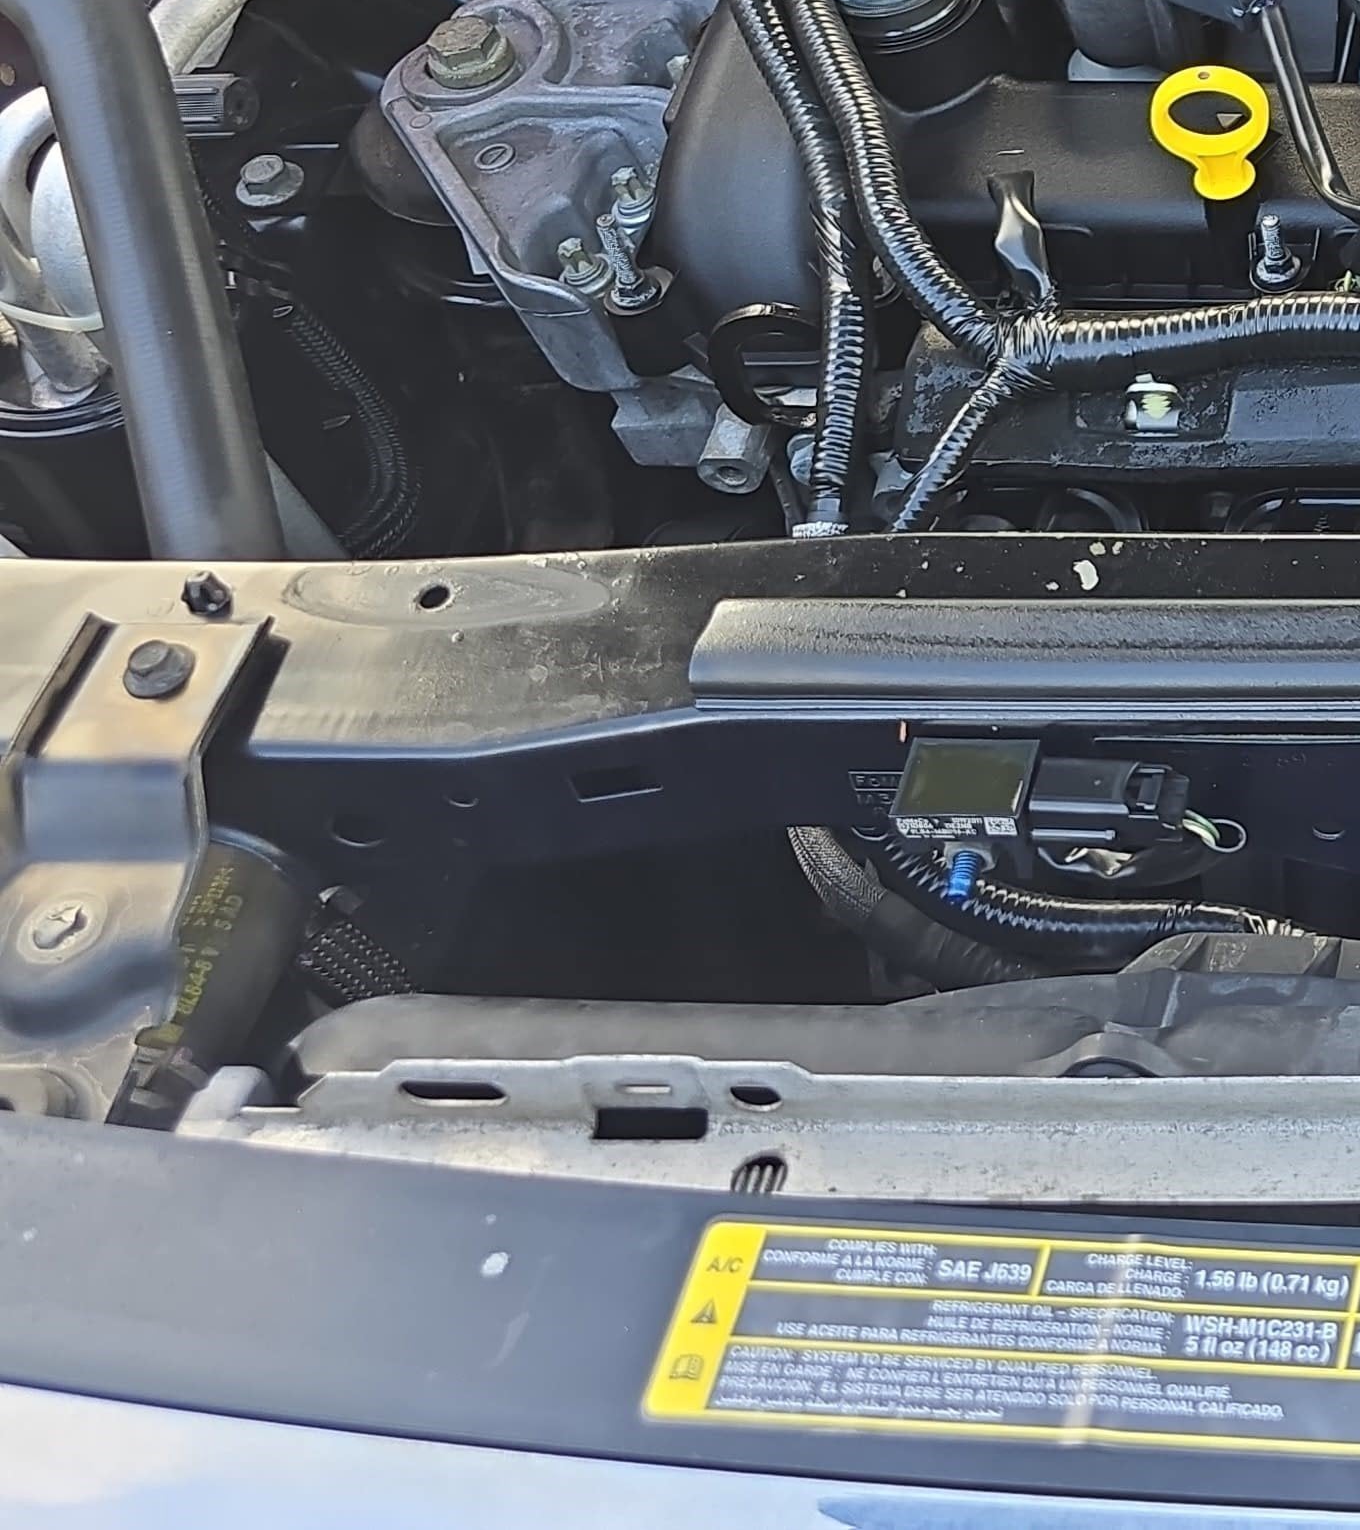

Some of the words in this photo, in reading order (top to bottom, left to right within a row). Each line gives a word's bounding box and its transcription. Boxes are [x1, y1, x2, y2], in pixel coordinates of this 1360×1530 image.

[828, 1239, 897, 1254] COMPLIES
[706, 1257, 744, 1273] A/C
[763, 1250, 840, 1266] CONFORME
[855, 1256, 874, 1268] LA
[875, 1256, 925, 1270] NORME
[1087, 1254, 1143, 1267] CHARGE
[1144, 1256, 1193, 1270] LEVEL:
[835, 1268, 892, 1282] CUMPLE
[936, 1260, 982, 1279] SAE
[983, 1263, 1032, 1286] J639
[1124, 1268, 1182, 1283] CHARGE
[1045, 1280, 1095, 1295] CARGA
[1096, 1282, 1118, 1296] DE
[1194, 1269, 1236, 1289] 1.56
[1239, 1272, 1259, 1289] lb
[1262, 1273, 1310, 1295] (0.71
[1313, 1276, 1351, 1301] kg)
[932, 1300, 1031, 1318] REFRIGERANT
[1032, 1305, 1054, 1318] OIL
[776, 1322, 806, 1335] USE
[806, 1324, 858, 1338] ACEITE
[860, 1327, 898, 1342] PARA
[900, 1330, 1016, 1346] REFRIGERANTES
[1018, 1335, 1097, 1350] CONFORME
[926, 1316, 969, 1330] HUILE
[971, 1318, 991, 1331] DE
[1113, 1324, 1163, 1339] NORME
[1184, 1314, 1338, 1339] WSH-M1C231-B
[1183, 1336, 1198, 1355] 5
[1201, 1337, 1217, 1355] fl
[1219, 1341, 1245, 1356] oz
[1248, 1339, 1292, 1360] (148
[1295, 1343, 1331, 1363] cc)
[802, 1350, 860, 1364] SYSTEM
[862, 1352, 880, 1365] TO
[904, 1357, 974, 1372] SERVICED
[975, 1358, 993, 1373] BY
[996, 1360, 1070, 1375] QUALIFIED
[724, 1361, 758, 1375] MISE
[760, 1362, 782, 1376] EN
[784, 1364, 833, 1378] GARDE
[846, 1367, 866, 1380] NE
[1080, 1378, 1163, 1395] PERSONNEL
[820, 1382, 838, 1394] EL
[840, 1383, 904, 1398] SISTEMA
[904, 1386, 943, 1399] DEBE
[944, 1387, 974, 1400] SER
[975, 1388, 1046, 1405] ATENDIDO
[1122, 1396, 1196, 1413] PERSONAL
